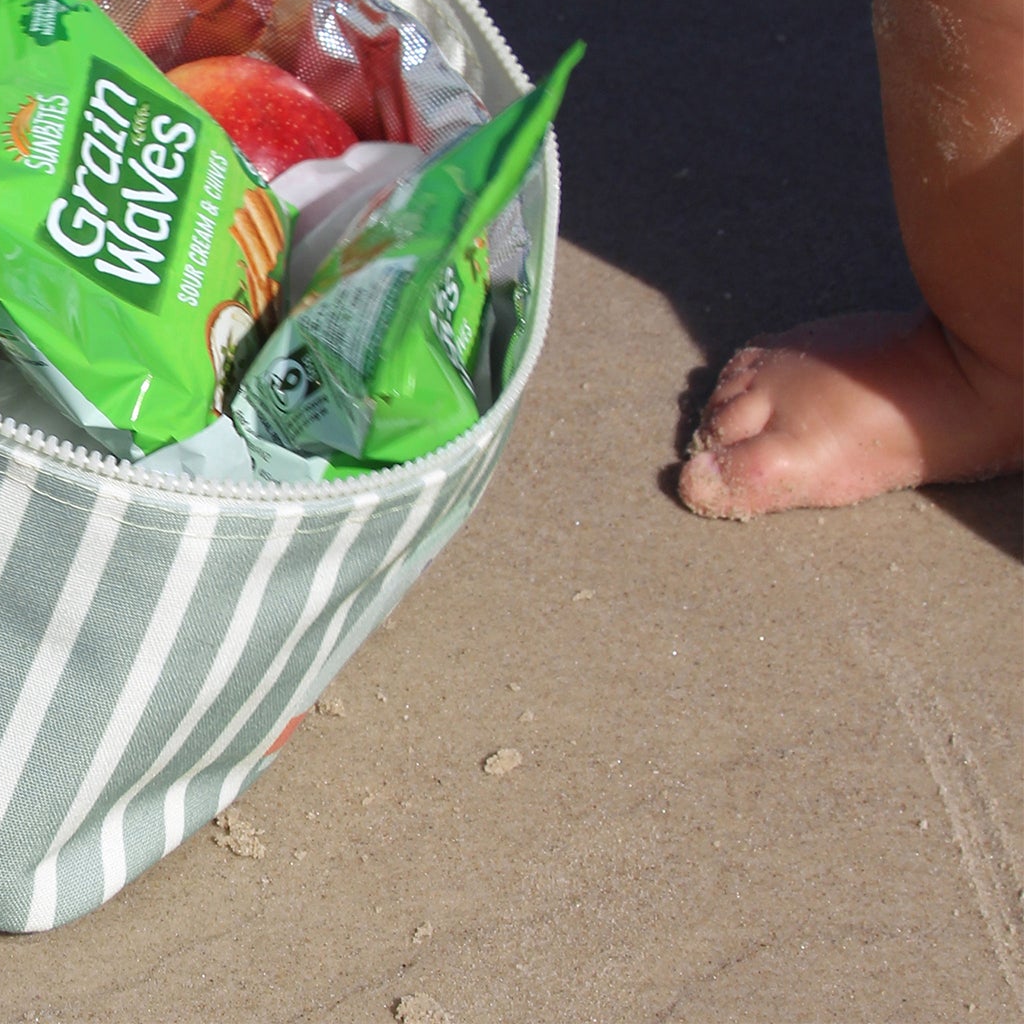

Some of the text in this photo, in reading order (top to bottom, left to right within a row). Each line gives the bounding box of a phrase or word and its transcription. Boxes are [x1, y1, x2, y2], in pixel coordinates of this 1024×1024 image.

[24, 93, 69, 175] SUNBITES
[46, 78, 137, 257] Grain
[177, 150, 228, 307] SOUR CREAM & CHIVES
